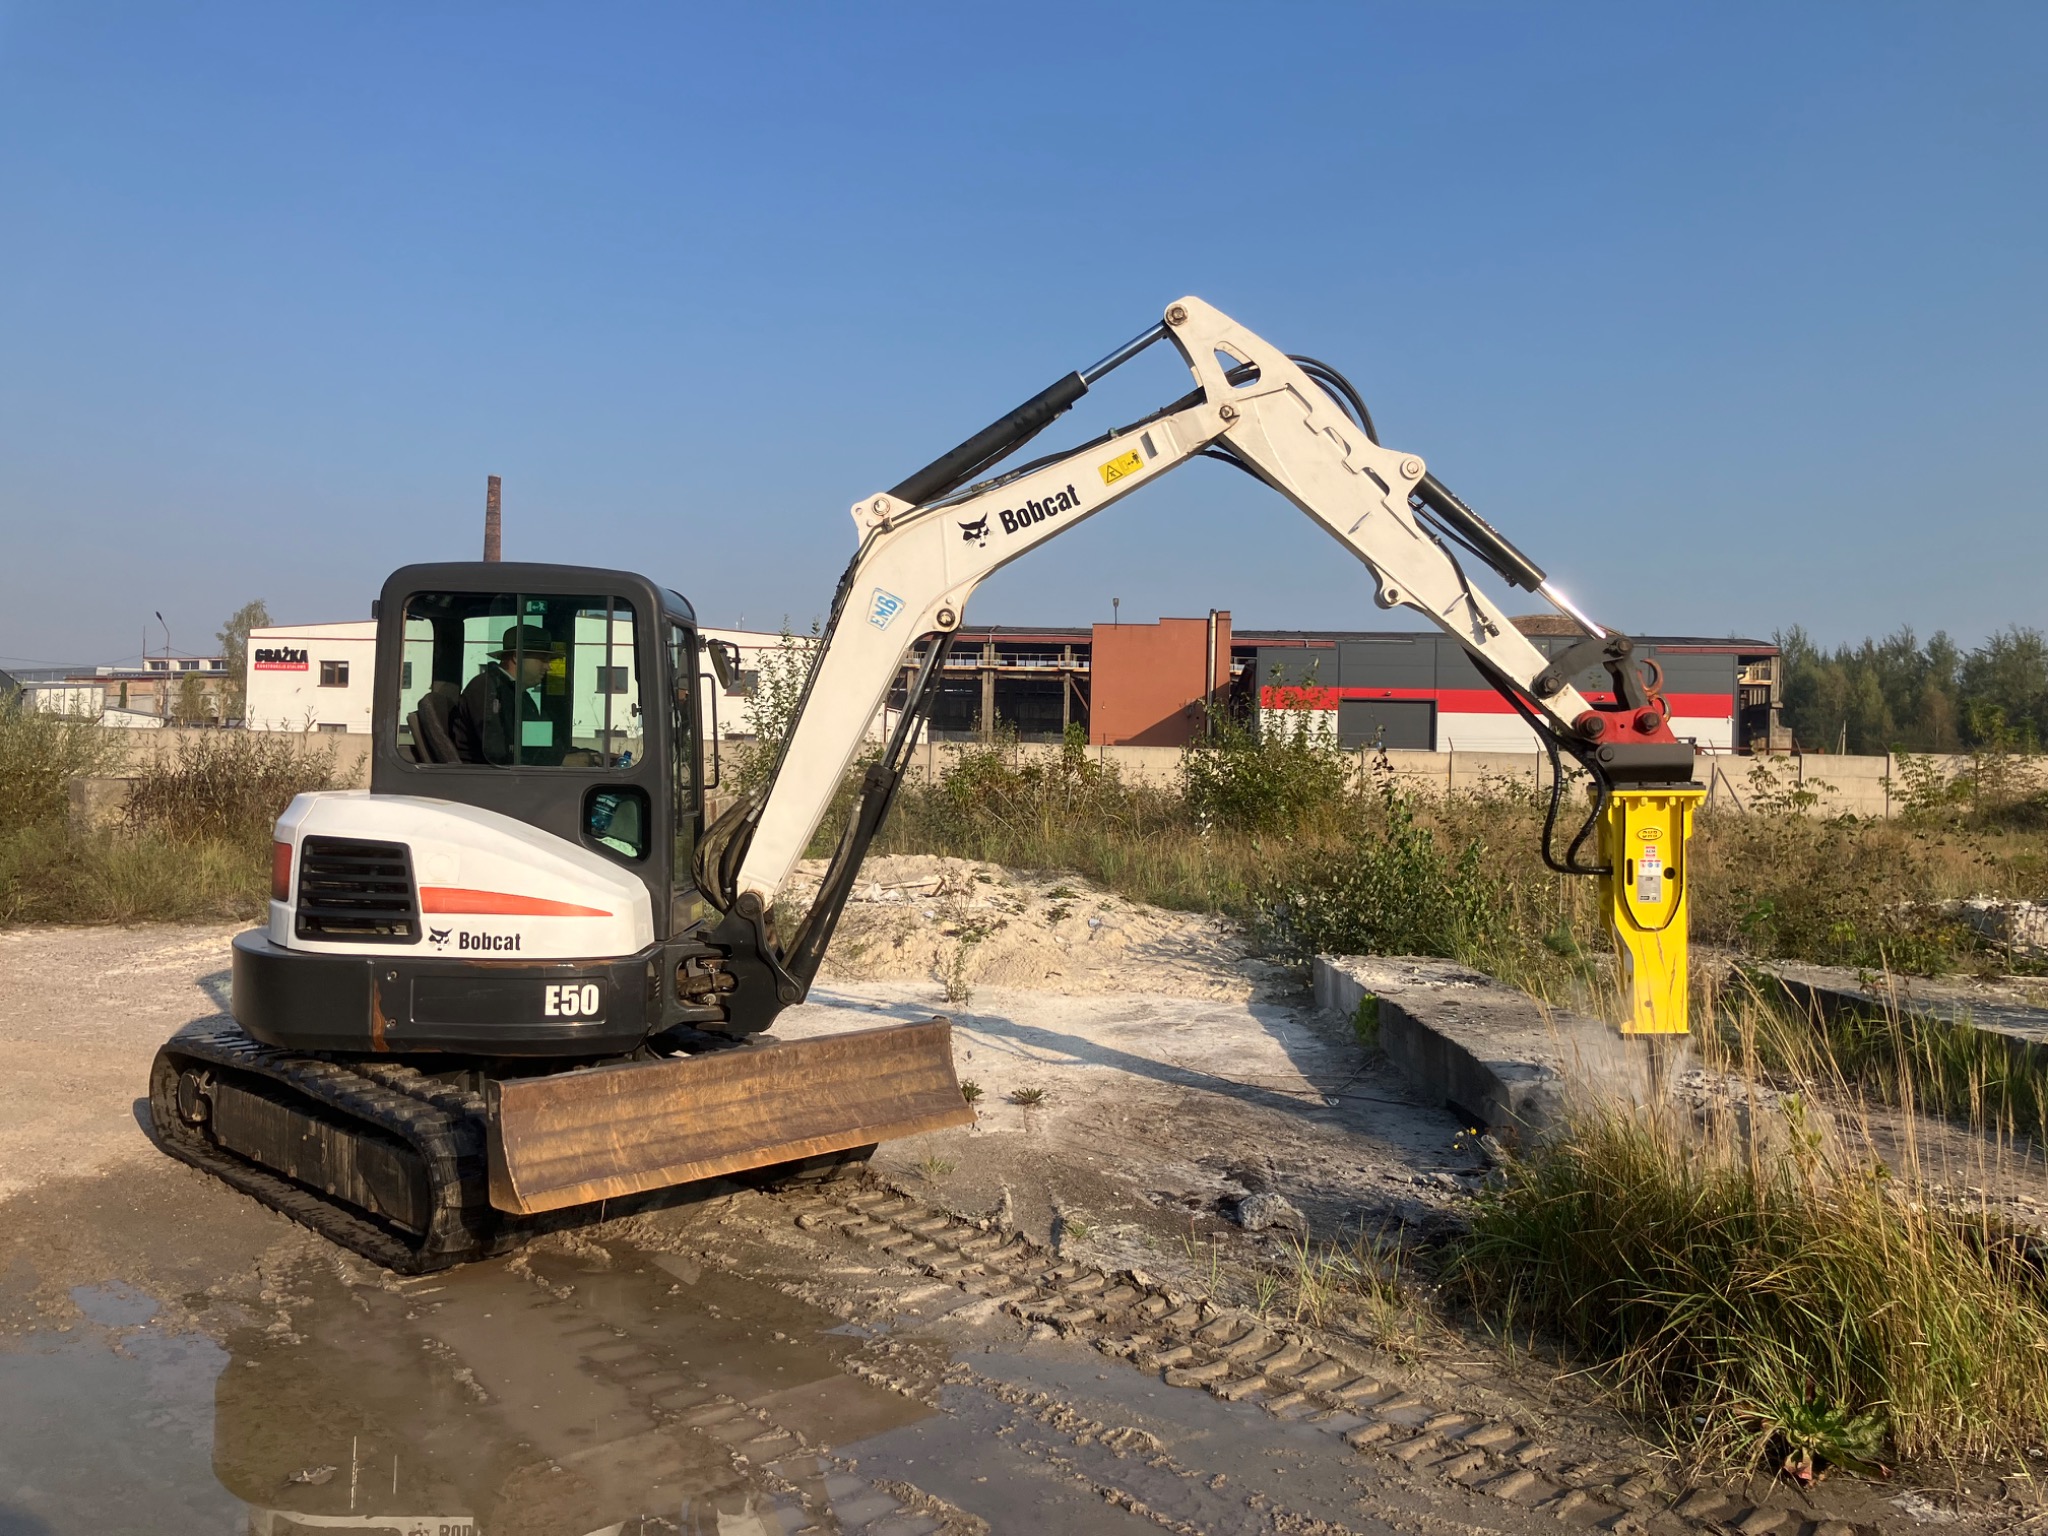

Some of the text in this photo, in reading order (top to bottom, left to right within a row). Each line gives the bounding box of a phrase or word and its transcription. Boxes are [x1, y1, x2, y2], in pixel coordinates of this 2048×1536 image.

[998, 483, 1081, 535] Bobcat
[458, 931, 521, 951] Bobcat
[544, 983, 600, 1016] E50
